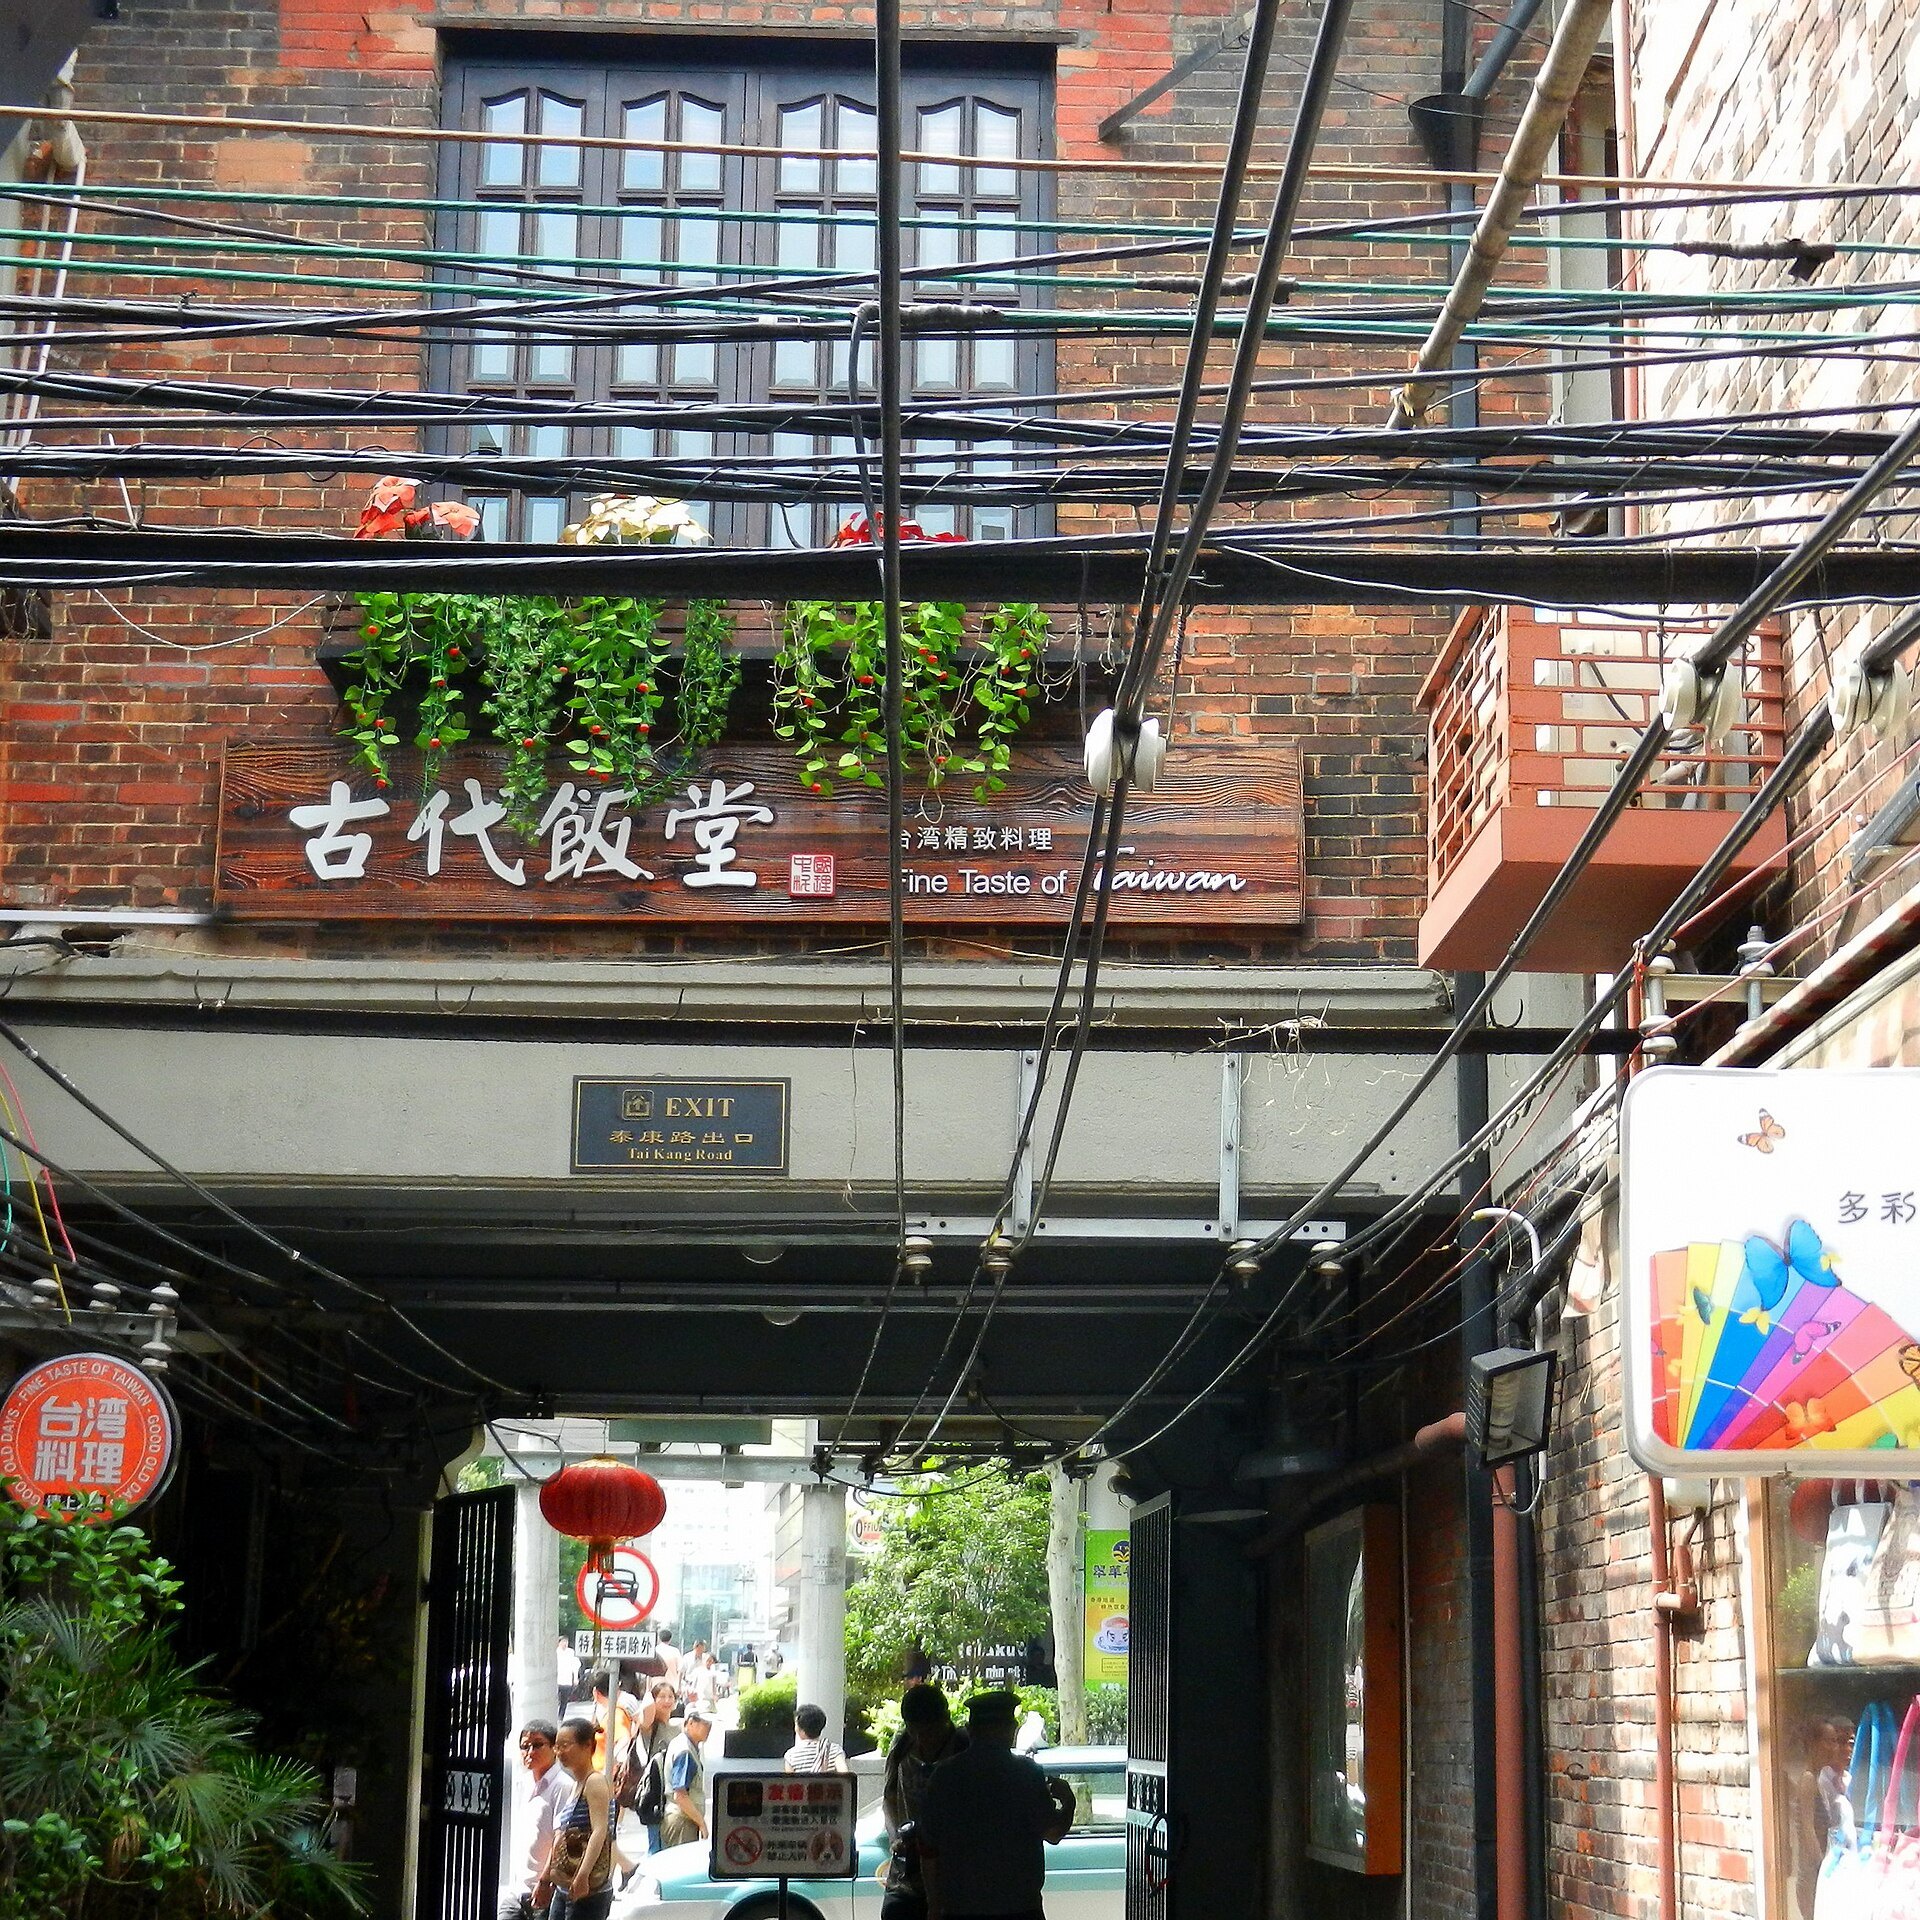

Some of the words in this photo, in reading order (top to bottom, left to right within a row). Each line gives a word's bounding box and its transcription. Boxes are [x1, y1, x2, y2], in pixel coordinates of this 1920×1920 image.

[289, 778, 775, 888] 古代飯堂
[958, 869, 1030, 893] Taste
[1041, 869, 1068, 894] of
[1093, 846, 1246, 891] Taiwan
[665, 1097, 735, 1118] EXIT
[609, 1130, 754, 1144] 泰康路出口
[628, 1148, 649, 1159] Tai
[654, 1149, 691, 1161] Kang
[696, 1149, 732, 1161] Road
[1838, 1191, 1917, 1223] 多彩
[19, 1375, 47, 1402] FINE
[46, 1361, 88, 1381] TASTE
[92, 1362, 110, 1376] OF
[111, 1368, 153, 1407] TAIWAN
[1, 1408, 20, 1442] DAYS
[40, 1395, 129, 1439] 台湾
[147, 1414, 161, 1453] GOOD
[33, 1440, 126, 1485] 料理
[138, 1456, 157, 1482] OLD
[579, 1633, 653, 1656] 特车辆除外
